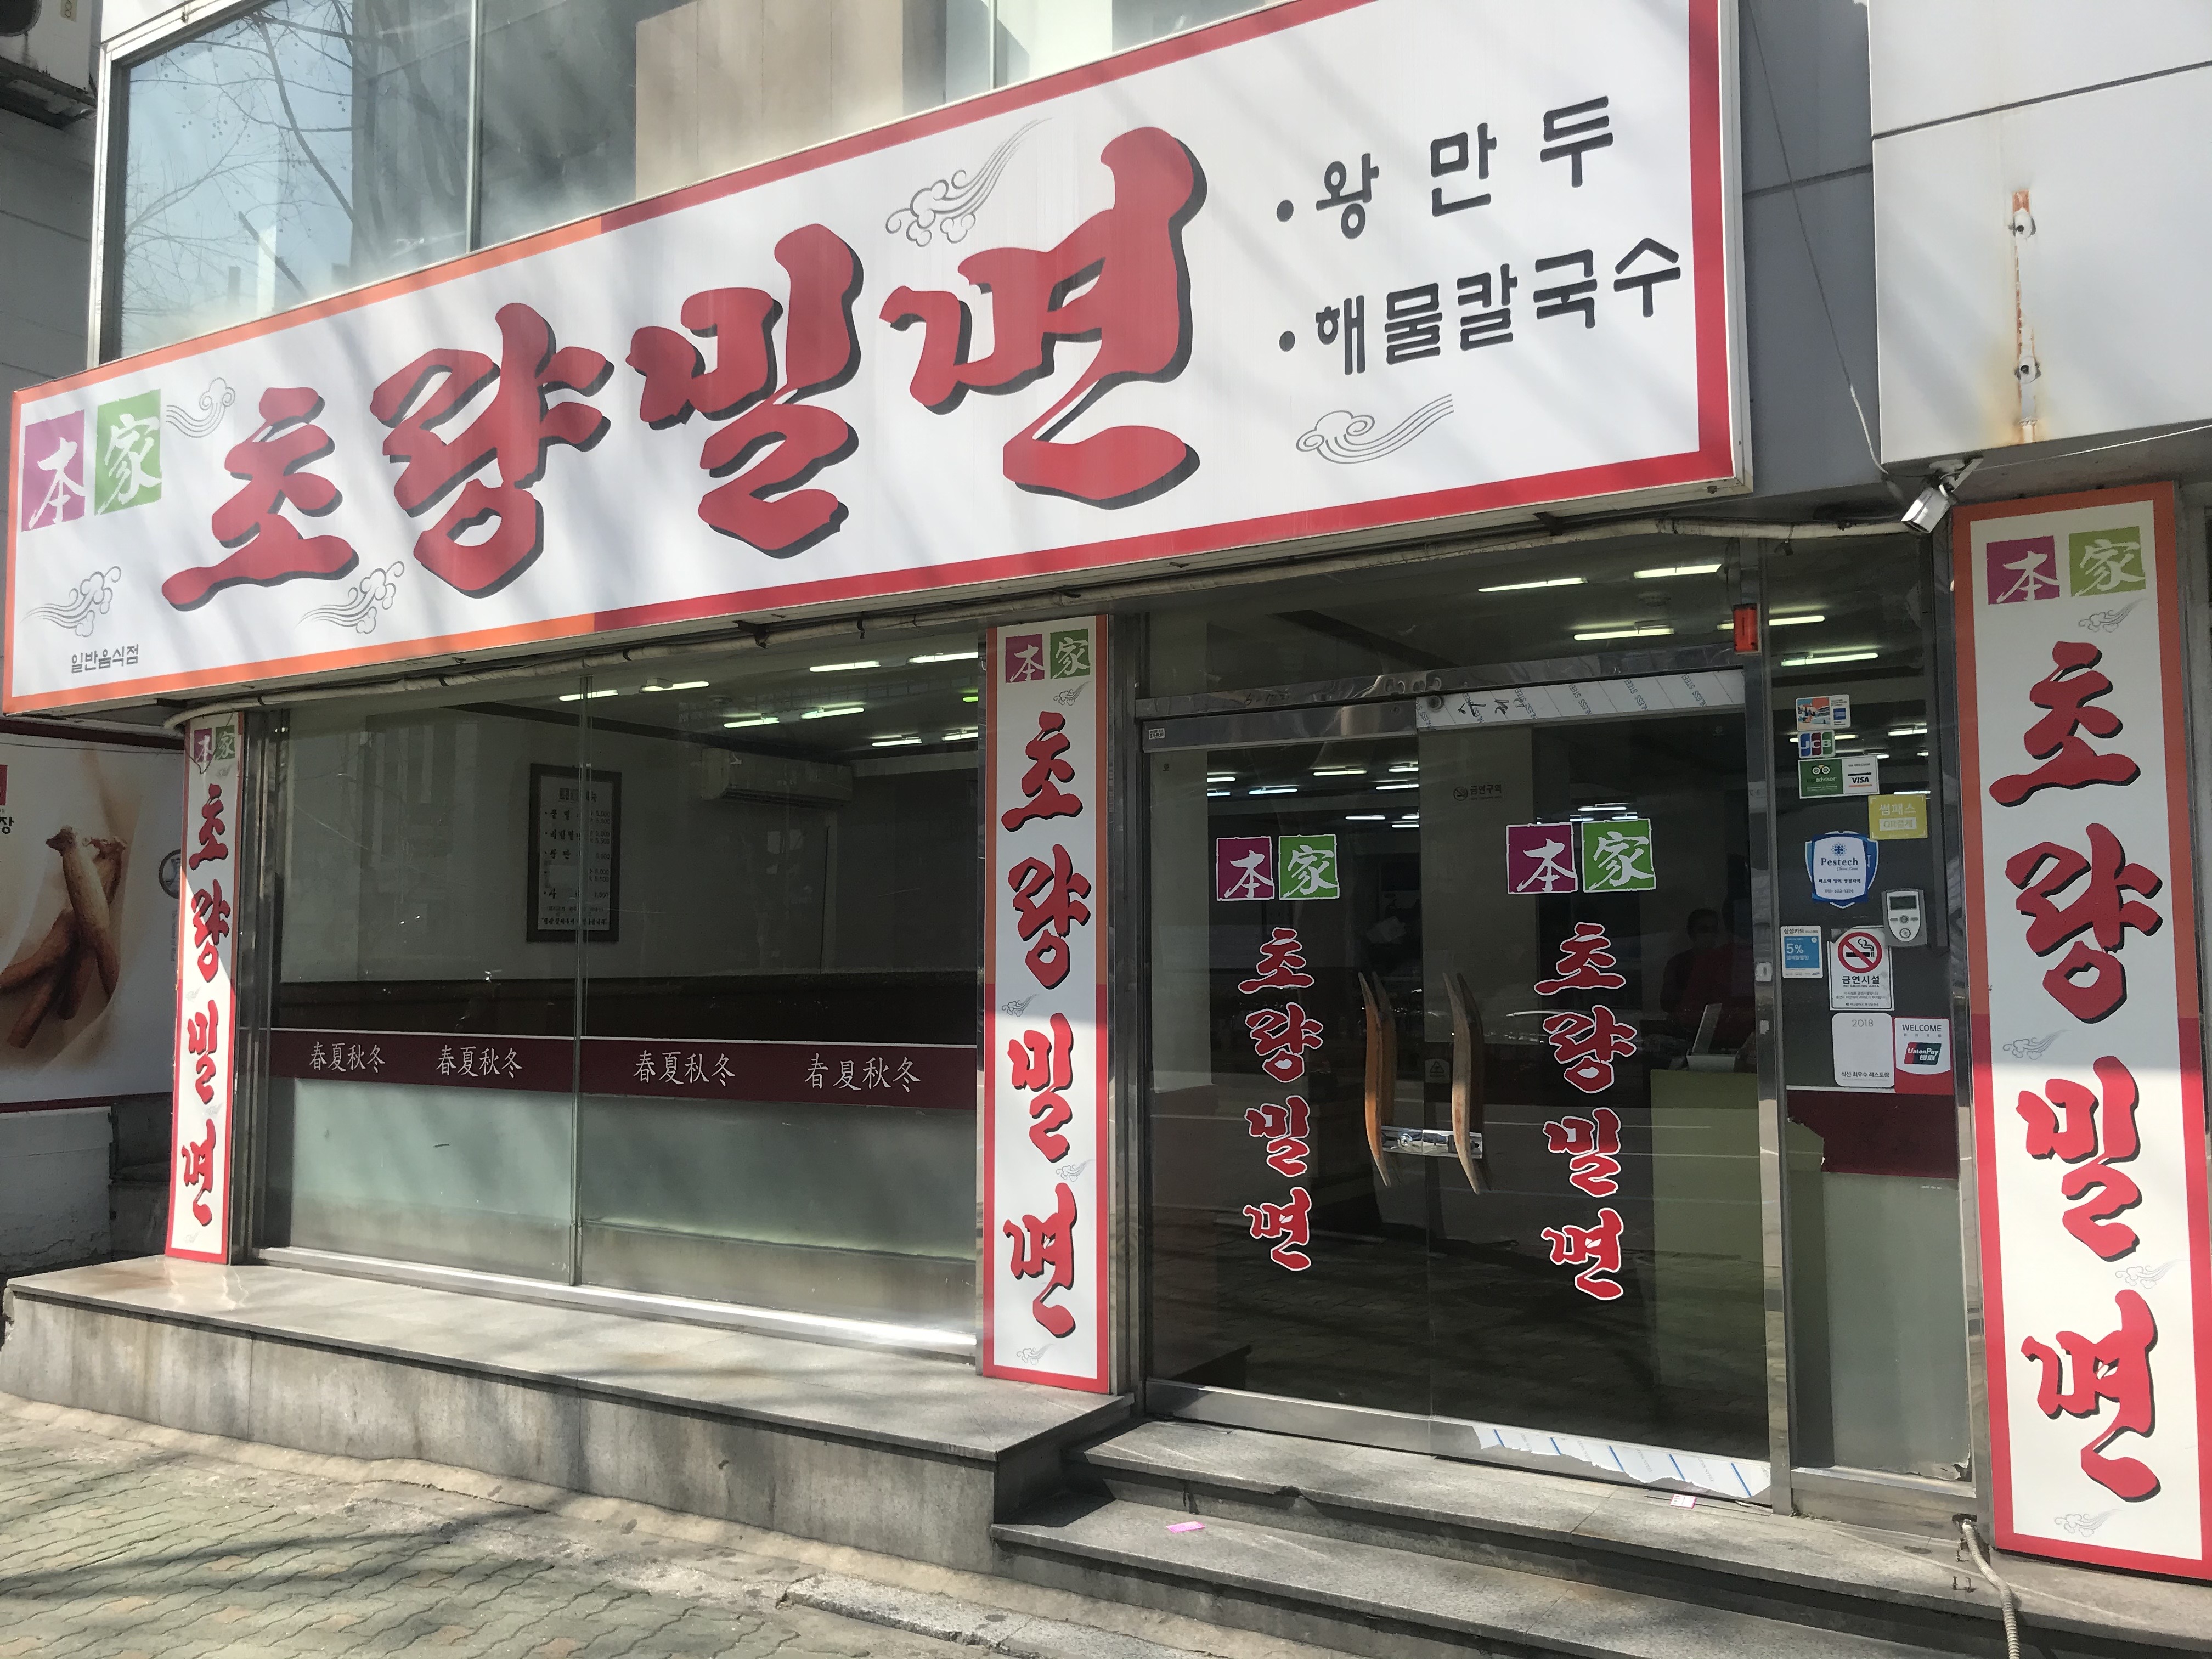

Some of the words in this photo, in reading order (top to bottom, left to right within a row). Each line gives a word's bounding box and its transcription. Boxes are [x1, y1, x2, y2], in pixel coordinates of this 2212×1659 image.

[1315, 237, 1681, 376] 해물칼국수
[161, 125, 1209, 613] 초량밀면
[29, 411, 163, 530] 本家
[1996, 537, 2147, 603] 本家
[70, 644, 140, 674] 일반음식점
[1007, 637, 1091, 683] 本家
[1799, 738, 1831, 749] JCB
[1878, 803, 1916, 816] 썸패스
[1223, 845, 1340, 898] 本家
[1516, 831, 1656, 893] 本家
[1821, 857, 1859, 866] Pestech
[1786, 943, 1804, 954] 5%
[1842, 975, 1880, 984] 금연시설
[182, 783, 231, 1228] 초량밀면
[1001, 710, 1092, 1339] 초량밀면
[1852, 1019, 1874, 1027] 2018
[309, 1041, 386, 1073] 春夏秋冬
[436, 1044, 523, 1079] 春夏秋冬
[633, 1049, 736, 1087] 春夏秋冬
[804, 1052, 921, 1093] 春夏秋冬
[1908, 1047, 1939, 1057] UnionPay
[1988, 641, 2163, 1503] 초량밀면
[1238, 927, 1324, 1271] 초량밀면
[1533, 922, 1637, 1301] 초량밀면
